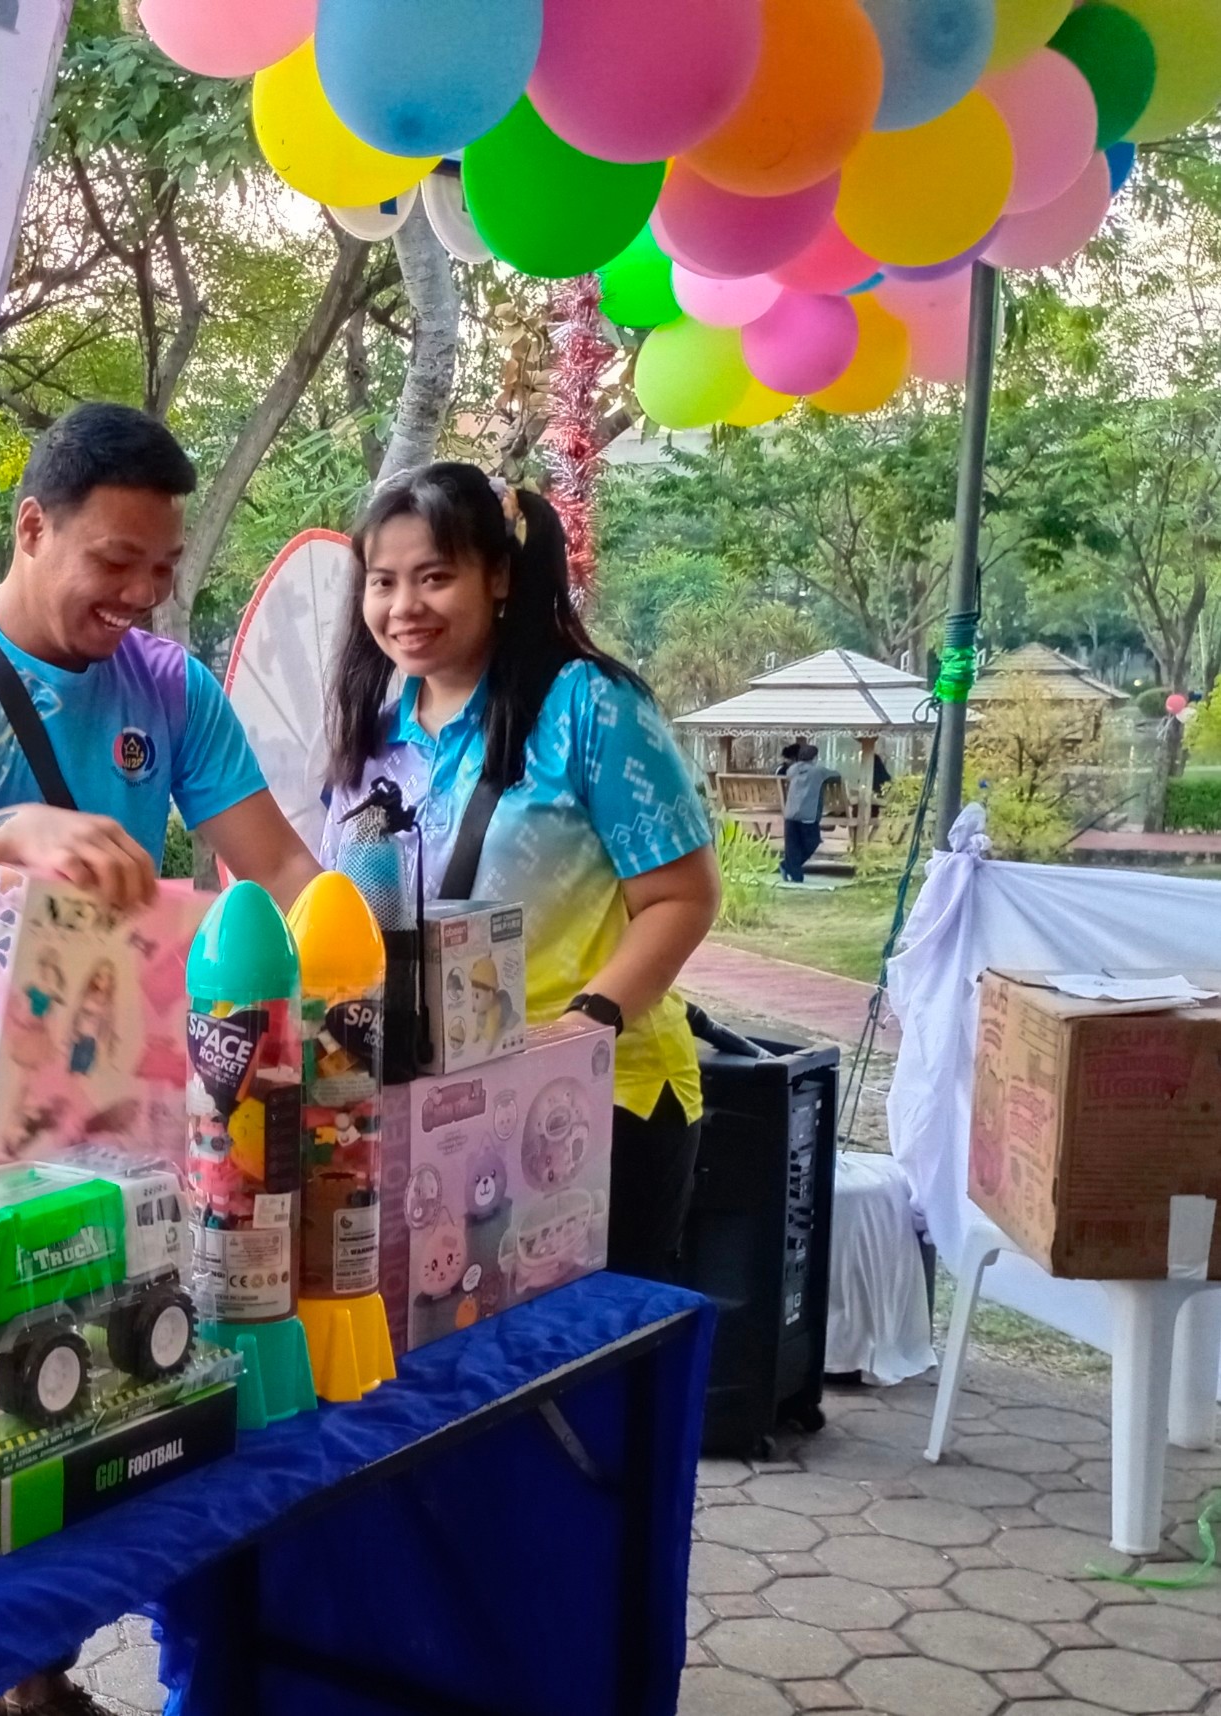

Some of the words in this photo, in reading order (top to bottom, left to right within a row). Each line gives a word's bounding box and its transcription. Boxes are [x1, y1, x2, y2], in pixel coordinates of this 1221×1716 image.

[188, 1012, 254, 1064] SPACE
[199, 1046, 246, 1076] ROCKET
[32, 1226, 100, 1271] TRUCK
[95, 1456, 125, 1492] GO!
[127, 1437, 184, 1480] FOOTBALL
